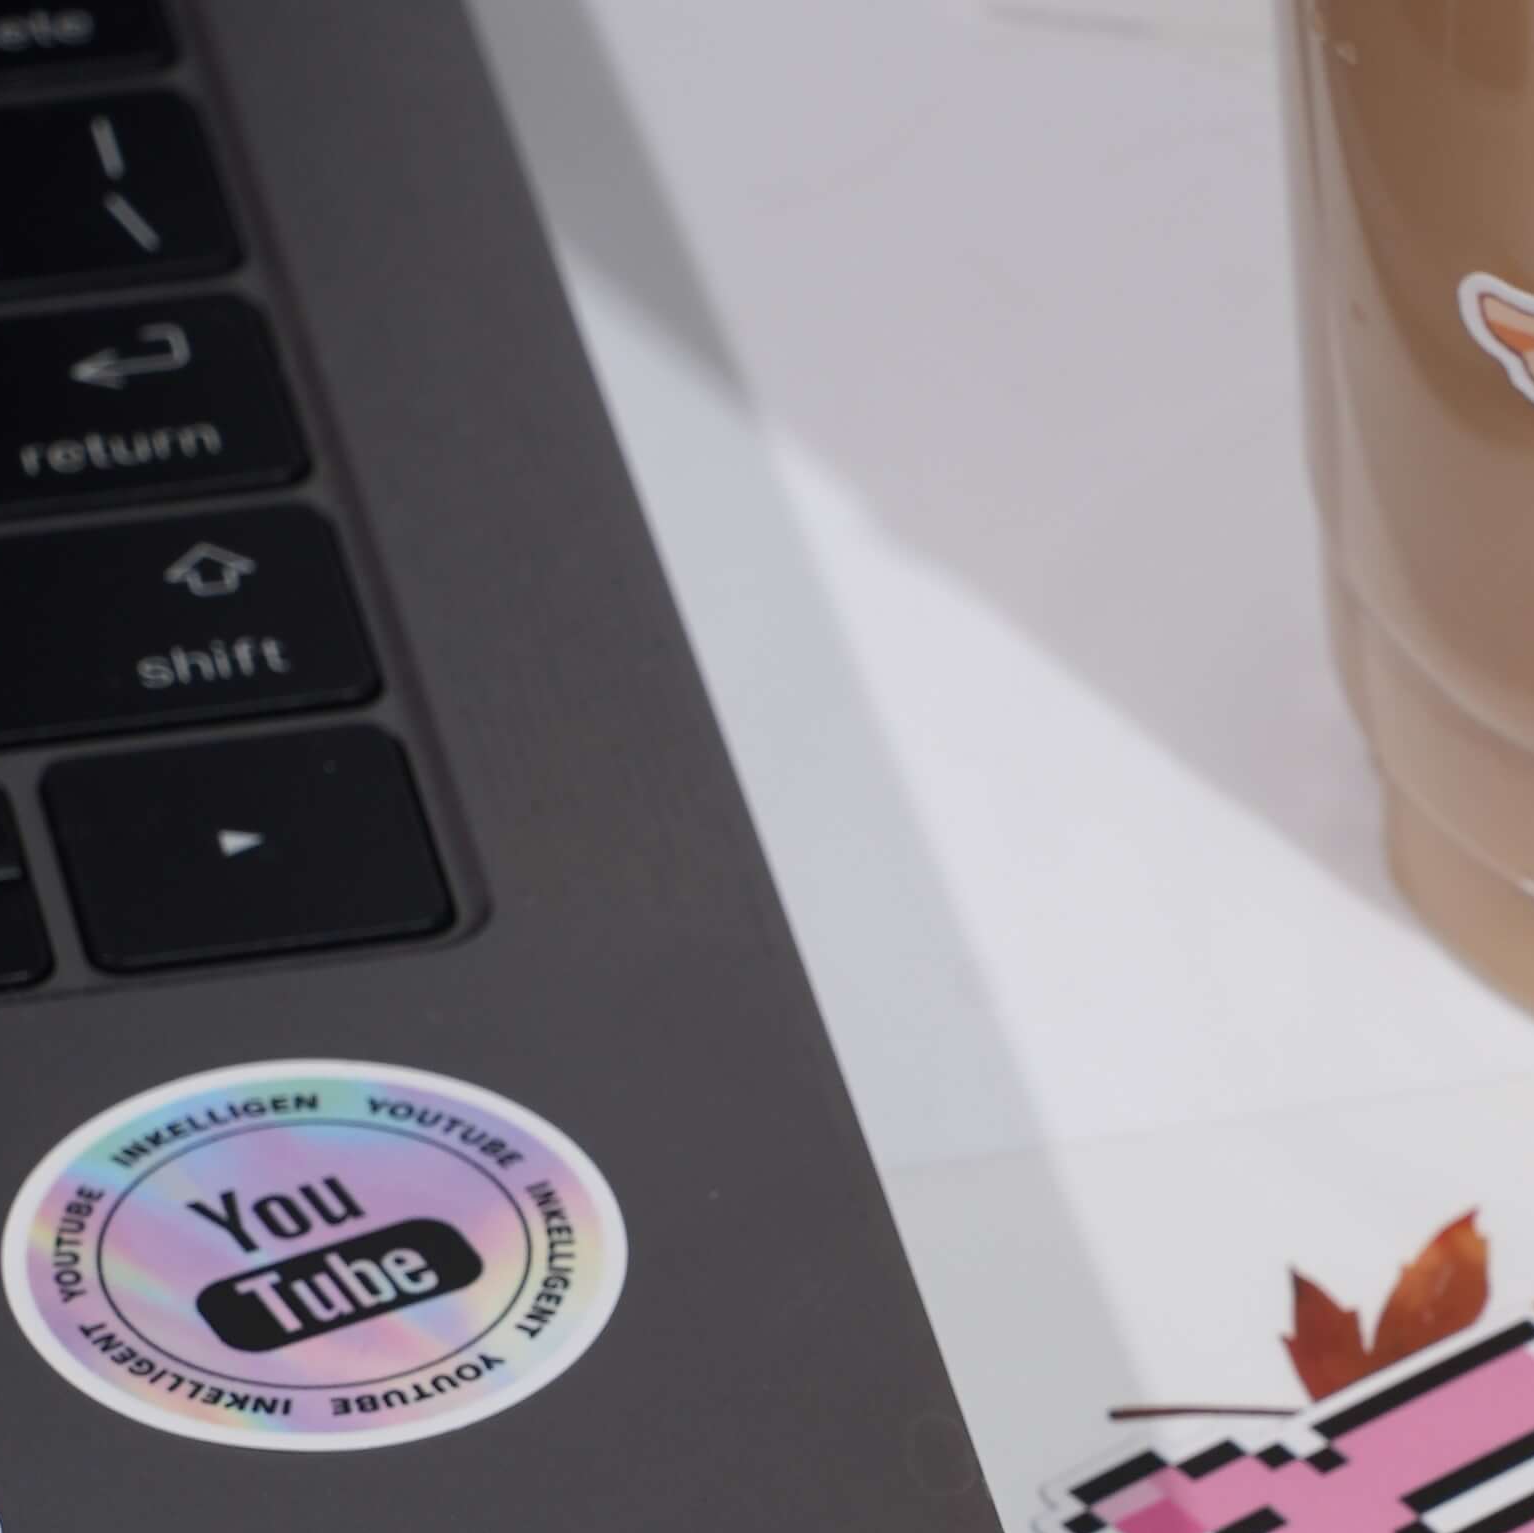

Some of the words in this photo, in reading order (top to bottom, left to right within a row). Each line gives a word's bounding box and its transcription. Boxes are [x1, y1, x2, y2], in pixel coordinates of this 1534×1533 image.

[20, 422, 221, 477] return
[137, 635, 291, 689] shift
[367, 1094, 525, 1171] YOUTUBE
[53, 1185, 106, 1304] YOUTUBE
[186, 1174, 366, 1255] You
[234, 1246, 441, 1335] Tube
[515, 1181, 577, 1342] INKELLIGENT
[77, 1320, 294, 1418] INKELLIGENT
[330, 1351, 507, 1418] YOUTUBE
